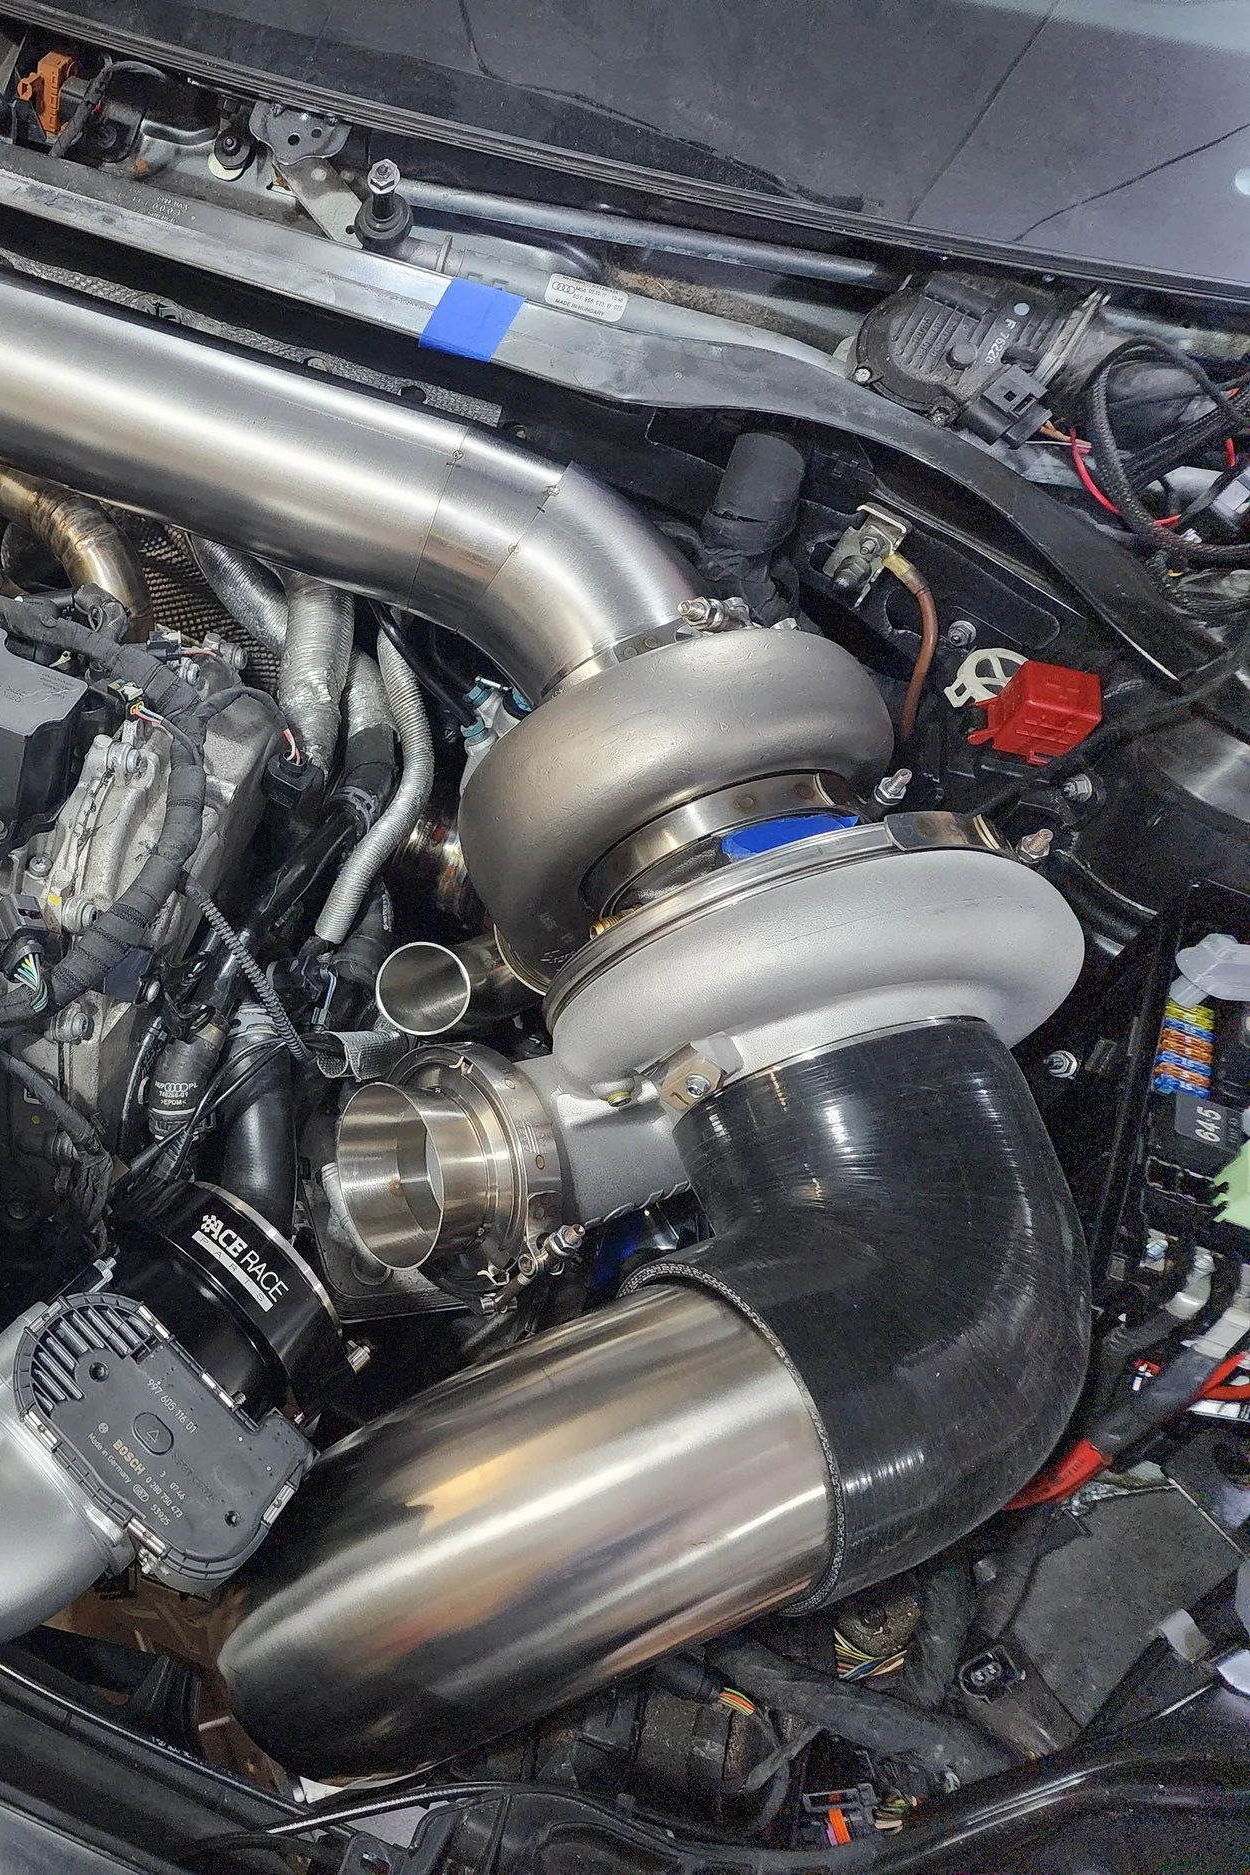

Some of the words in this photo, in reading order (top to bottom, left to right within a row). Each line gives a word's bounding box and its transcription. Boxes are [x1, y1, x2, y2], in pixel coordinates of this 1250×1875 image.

[554, 298, 570, 307] MADE
[578, 304, 606, 317] HUNGARY
[1004, 318, 1017, 330] F
[200, 1237, 265, 1302] PARTS
[240, 1250, 289, 1303] RACE
[147, 1378, 163, 1395] 997
[160, 1395, 177, 1411] 605
[175, 1409, 188, 1424] 116
[185, 1420, 198, 1434] 01
[87, 1432, 103, 1451] Made
[107, 1453, 132, 1484] Germany
[112, 1439, 146, 1475] BOSCH
[150, 1481, 163, 1495] 280
[160, 1492, 173, 1507] 750
[171, 1505, 183, 1518] 473
[150, 1504, 171, 1526] 53925
